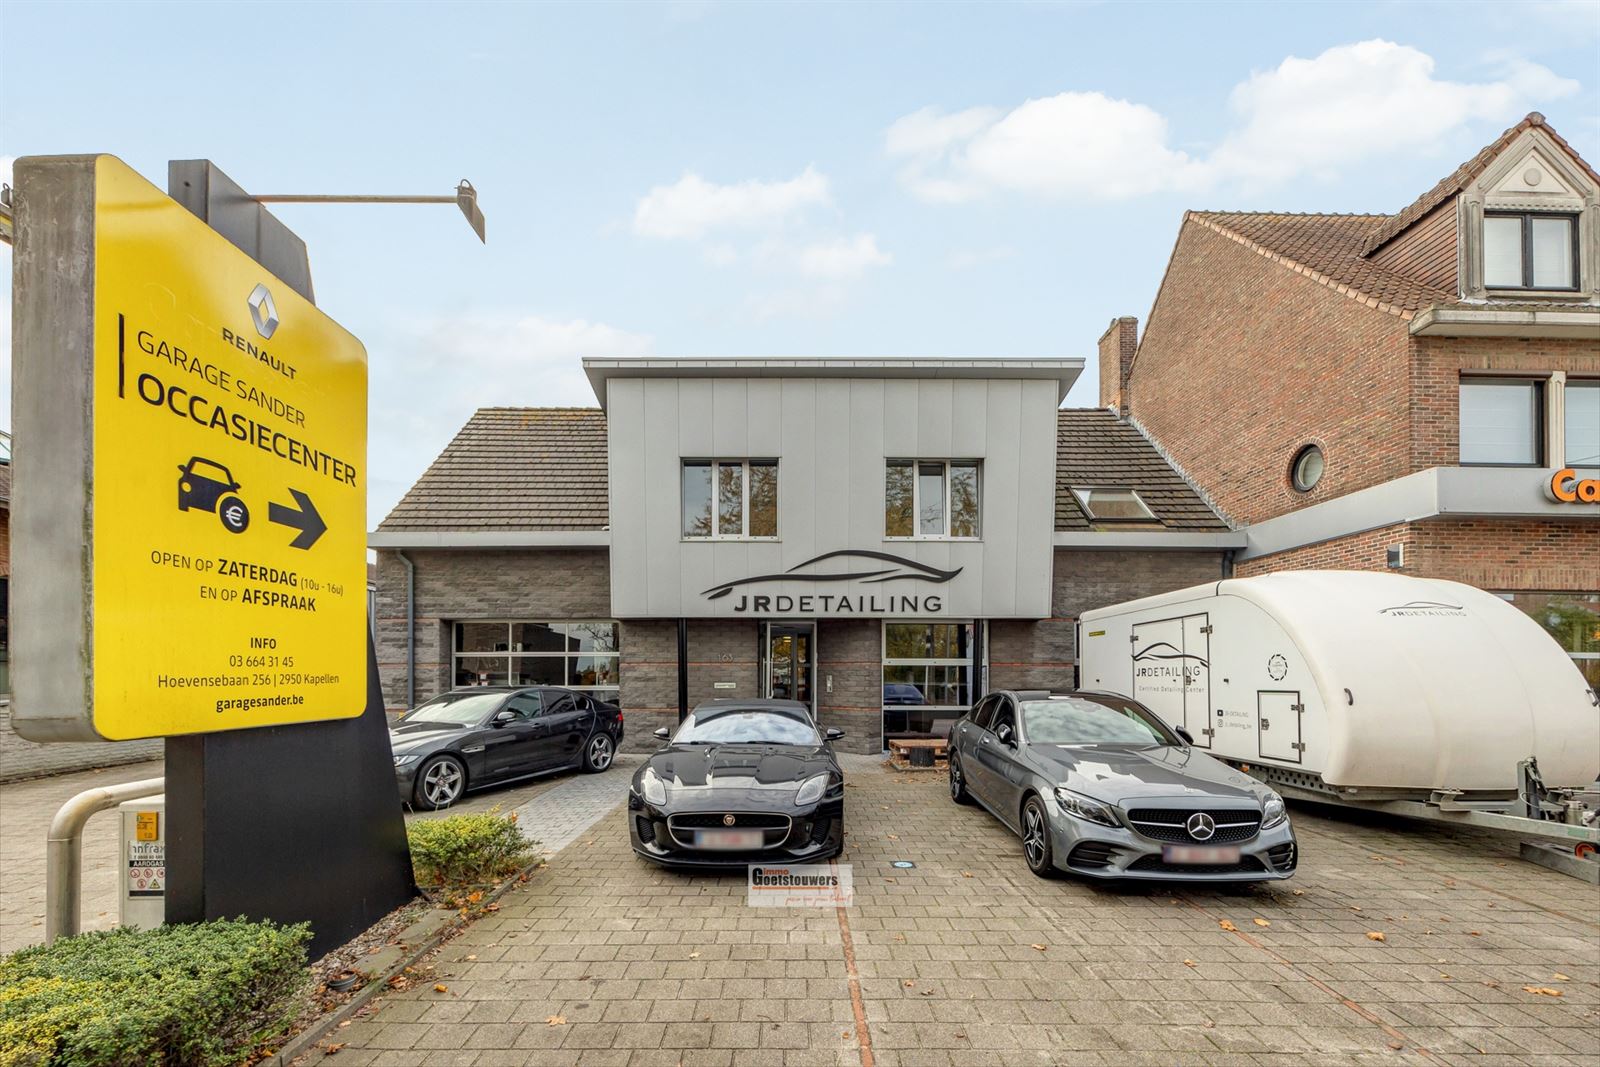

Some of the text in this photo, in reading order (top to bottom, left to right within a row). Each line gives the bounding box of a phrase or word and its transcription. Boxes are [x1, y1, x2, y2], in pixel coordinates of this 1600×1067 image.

[222, 327, 297, 380] RENAULT
[137, 330, 306, 429] GARAGE SANDER
[137, 373, 357, 488] OCCASIECENTER
[151, 550, 191, 569] OPEN
[195, 558, 214, 572] OP
[217, 558, 298, 587] ZATERDAG
[300, 577, 320, 591] (10u
[327, 582, 344, 597] 16u)
[200, 585, 317, 612] EN OP AFSPRAAK
[734, 595, 943, 613] JRDETAILING
[250, 637, 277, 650] INFO
[229, 655, 294, 668] 03 664 31 45
[158, 674, 250, 688] Hoevensebaan
[252, 674, 271, 686] 256
[279, 673, 302, 686] 2950
[304, 673, 340, 687] Kapellen
[1136, 666, 1201, 677] JRDETAILING
[216, 694, 304, 713] garagesander.be
